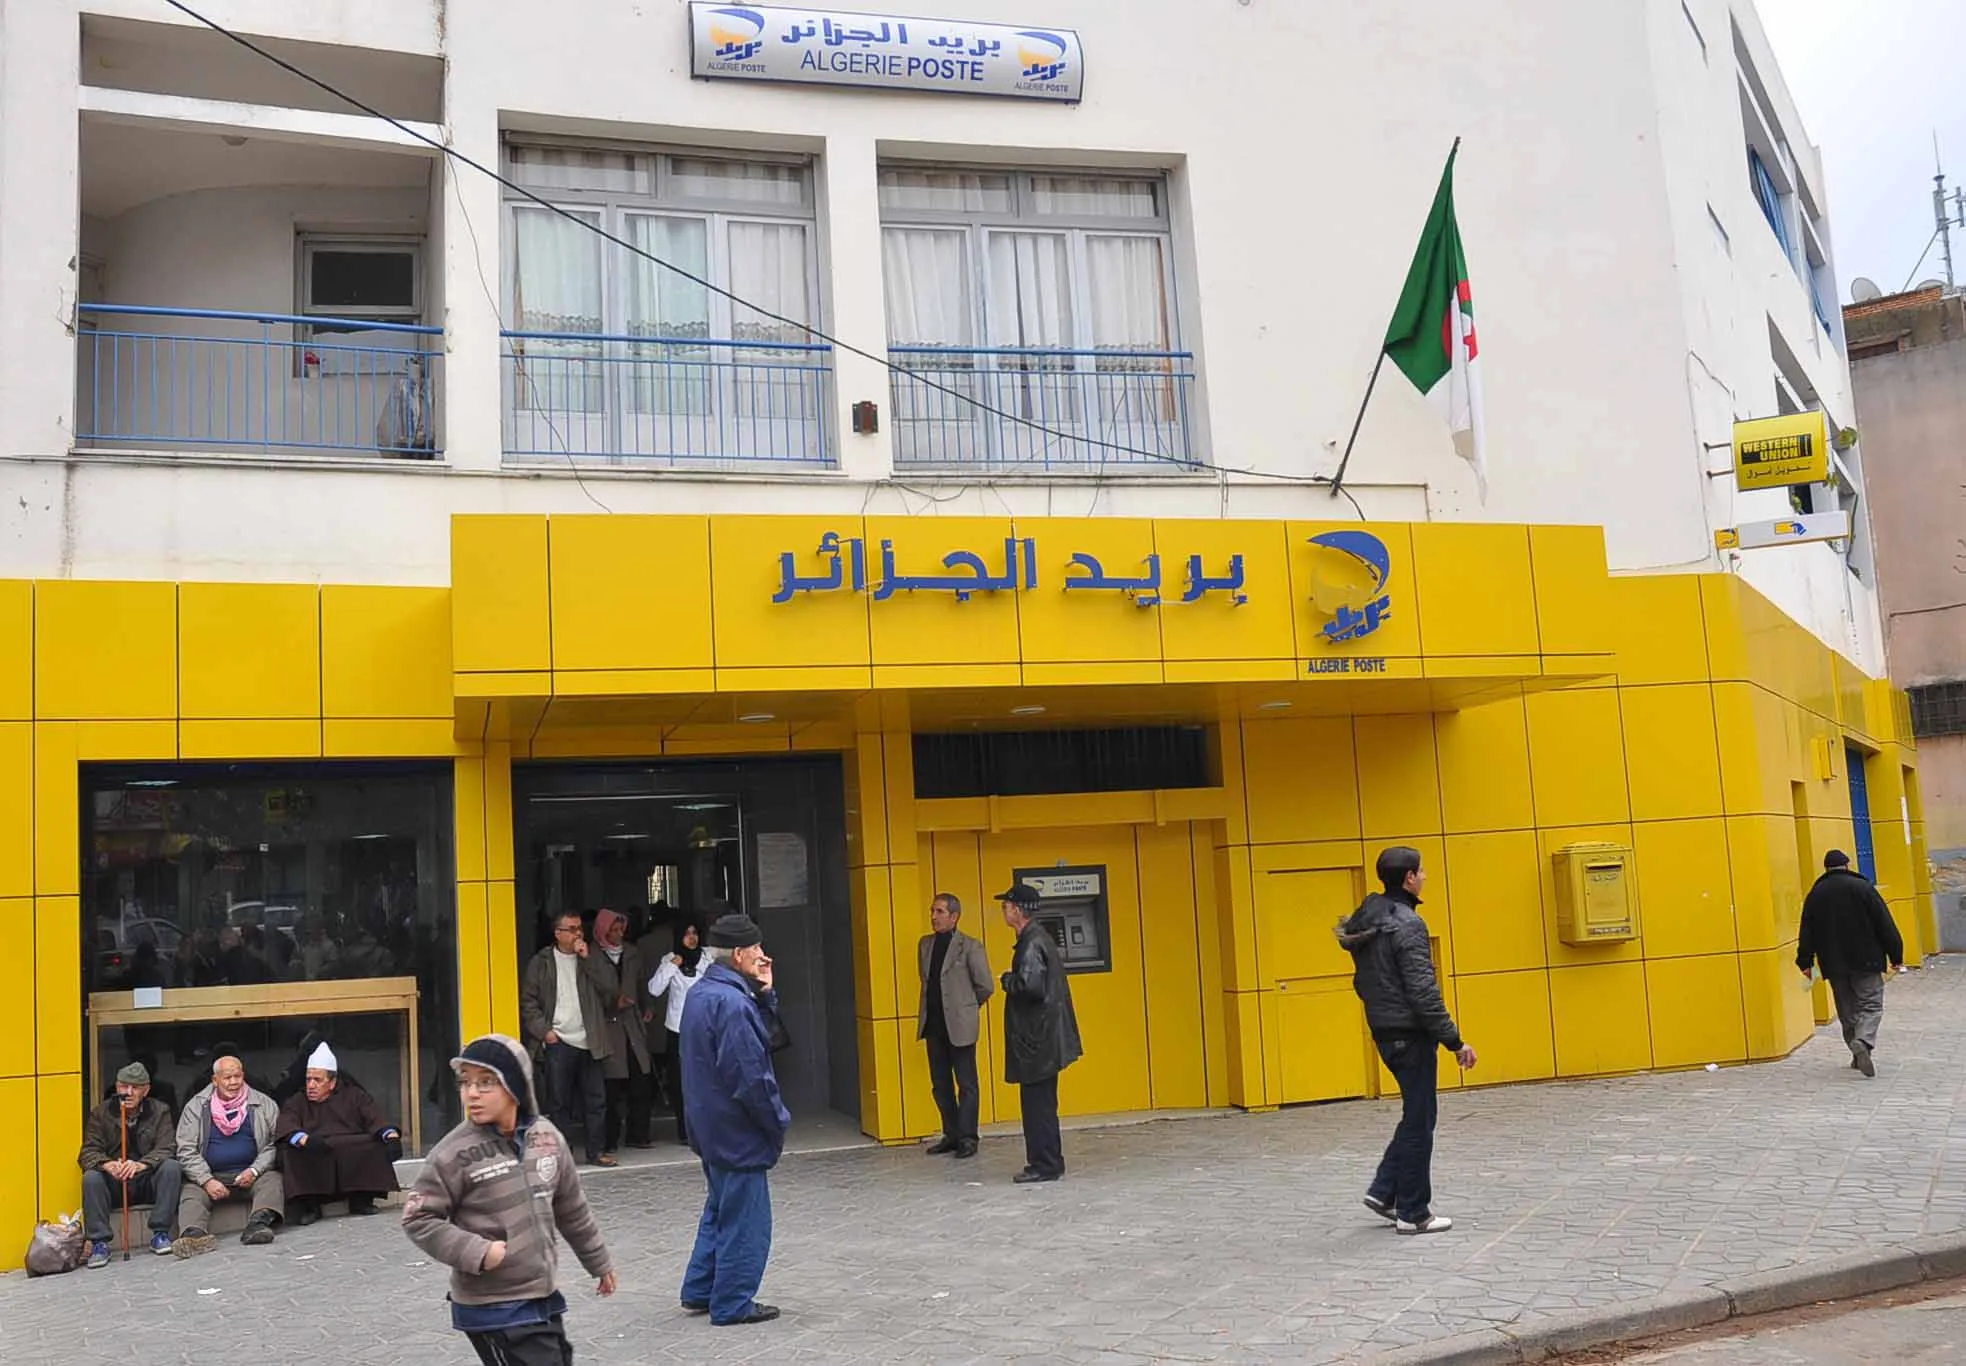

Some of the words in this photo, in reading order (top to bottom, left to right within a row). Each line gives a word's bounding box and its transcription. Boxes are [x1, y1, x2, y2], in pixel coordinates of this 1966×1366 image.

[928, 34, 1001, 57] بريد
[707, 61, 740, 72] ALGERIE
[741, 63, 767, 73] POSTE
[801, 49, 902, 76] ALGERIE
[907, 56, 985, 81] POSTE
[1046, 83, 1069, 93] POSTE
[1743, 437, 1798, 453] WESTERN
[1760, 447, 1798, 461] UNION
[772, 532, 1037, 604] الجزائر
[1063, 552, 1248, 607] بريد
[1308, 659, 1350, 673] ALGERIE
[1354, 658, 1386, 673] POSTE
